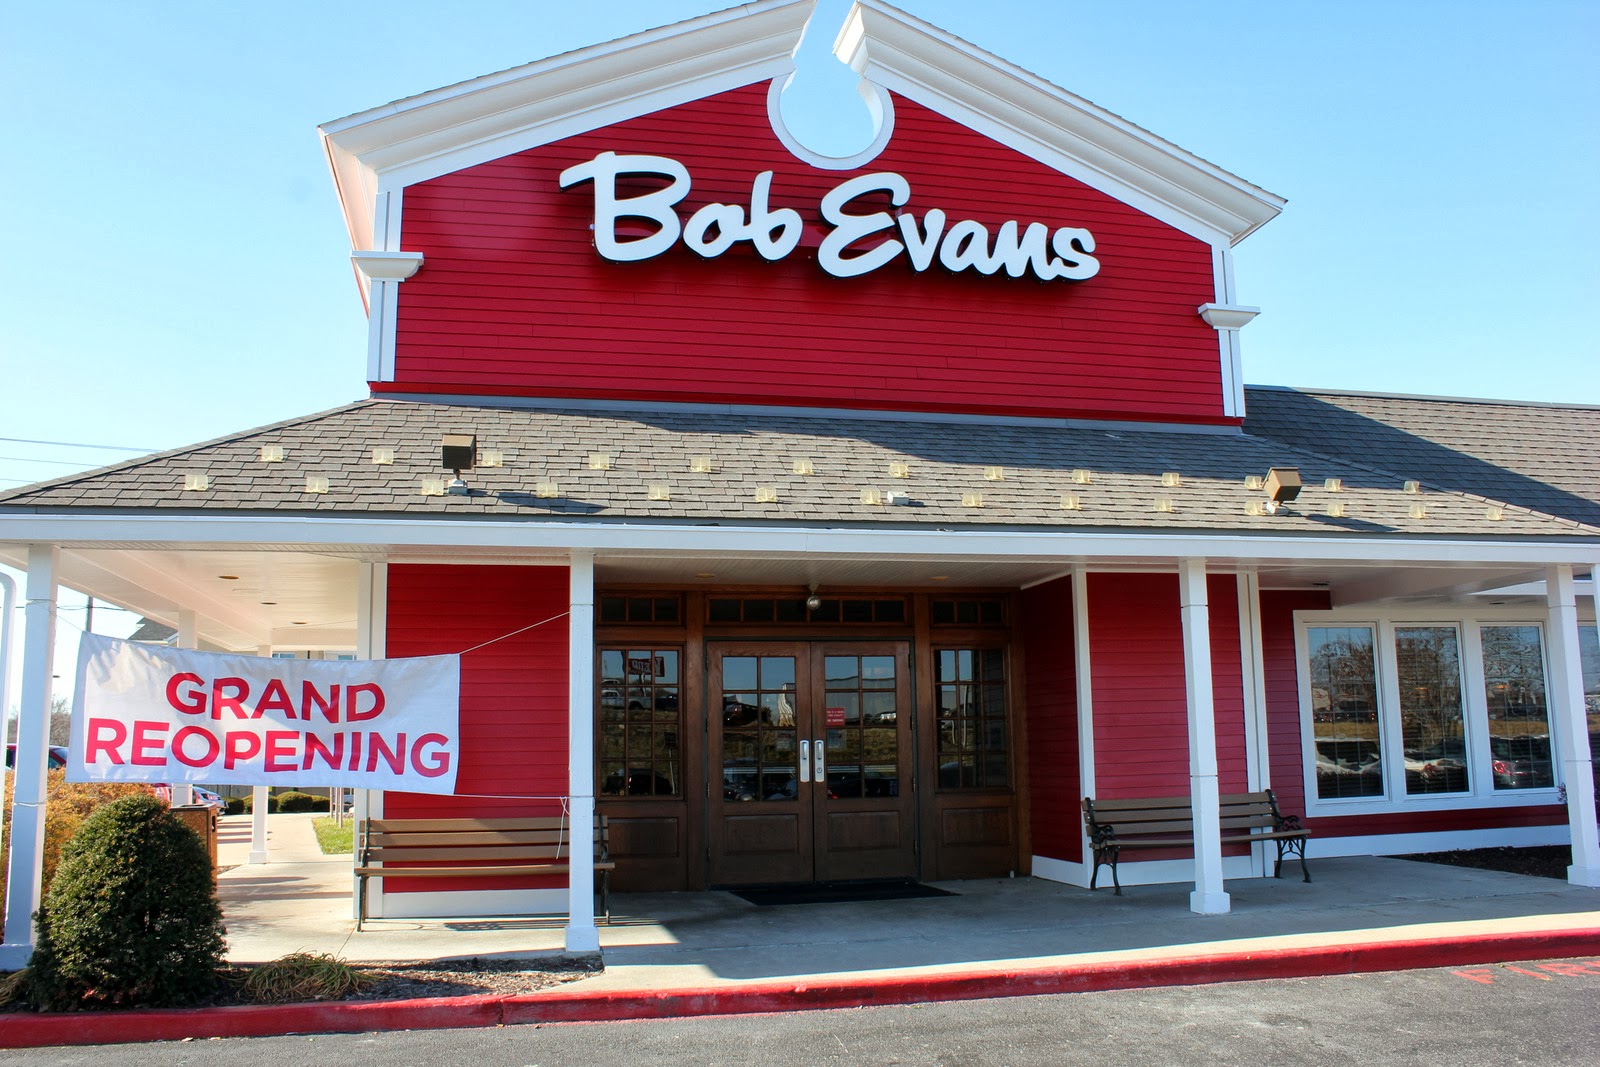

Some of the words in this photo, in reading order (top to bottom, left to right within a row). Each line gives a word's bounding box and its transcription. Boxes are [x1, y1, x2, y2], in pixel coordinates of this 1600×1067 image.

[559, 151, 803, 262] Bob
[817, 171, 1101, 281] Evans
[165, 672, 386, 723] GRAND
[84, 717, 451, 778] REOPENING
